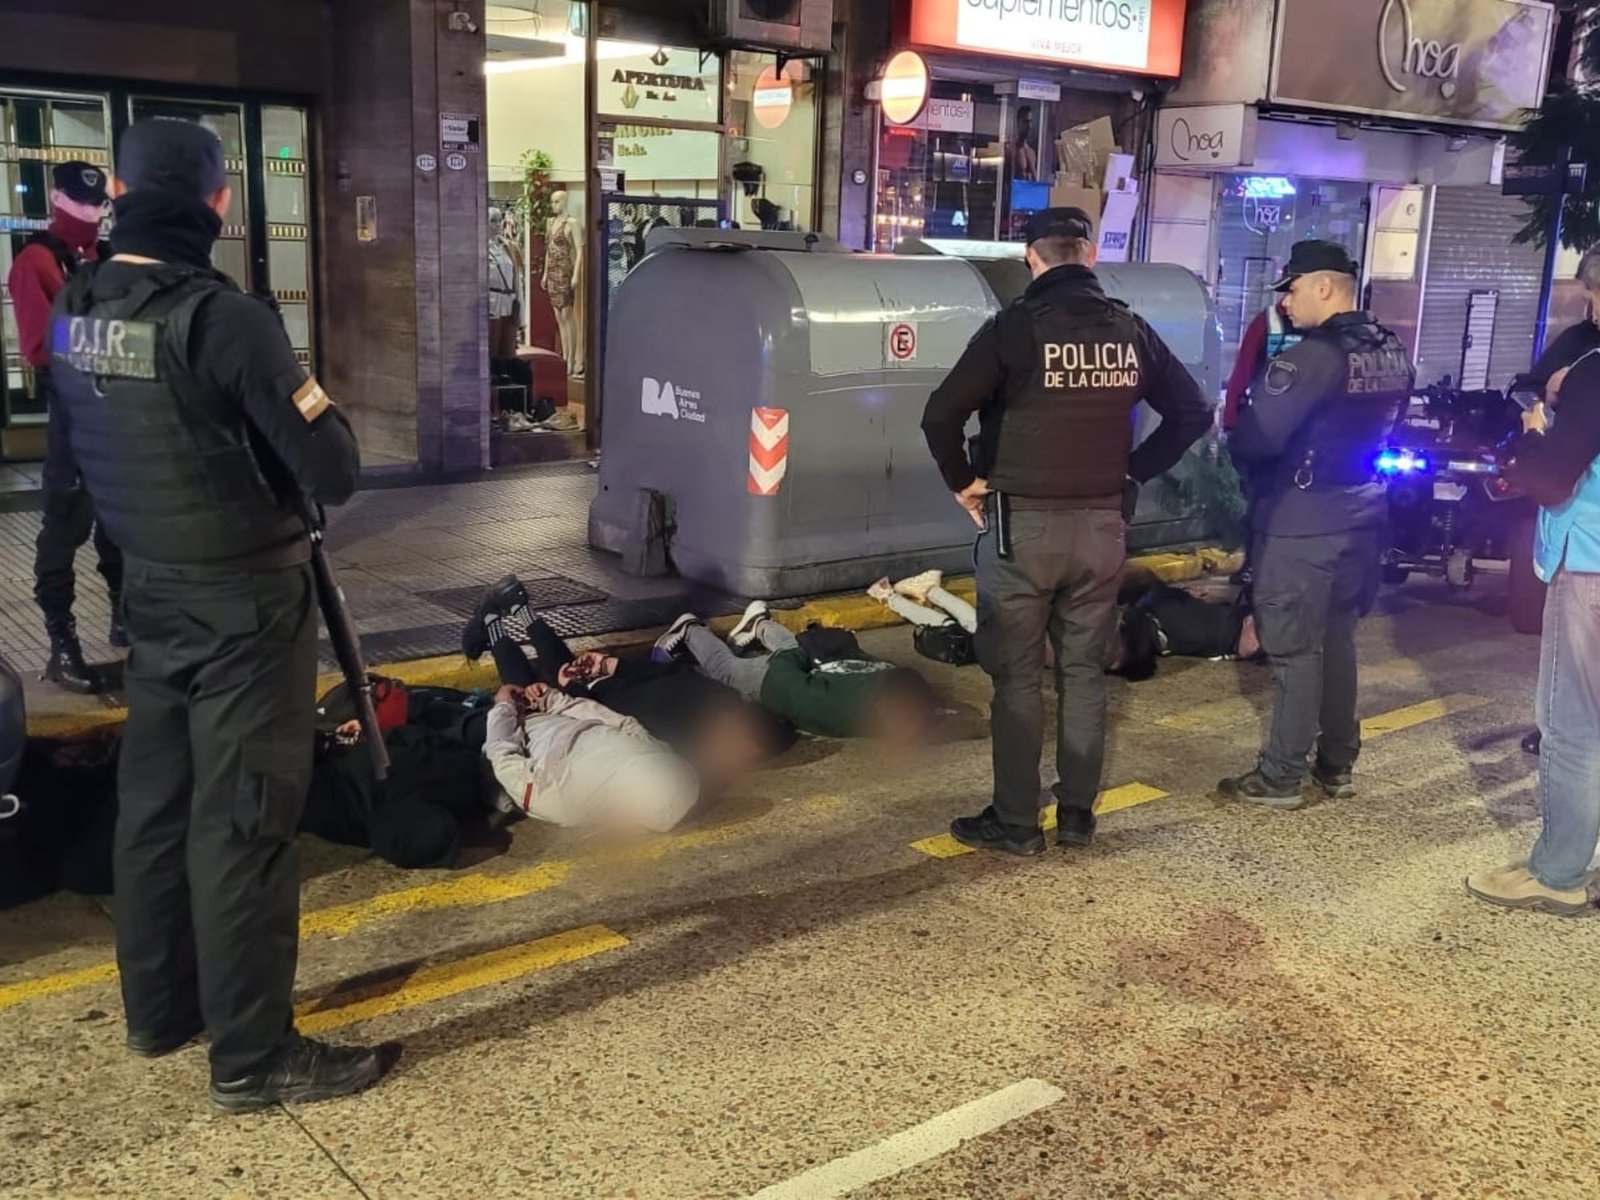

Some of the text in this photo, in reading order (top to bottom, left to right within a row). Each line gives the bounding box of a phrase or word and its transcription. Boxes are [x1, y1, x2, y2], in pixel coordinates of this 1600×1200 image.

[968, 0, 1131, 30] pementos
[612, 68, 705, 91] APERTURA
[1044, 343, 1139, 369] POLICIA
[1044, 370, 1139, 388] DE LA CIUDAD
